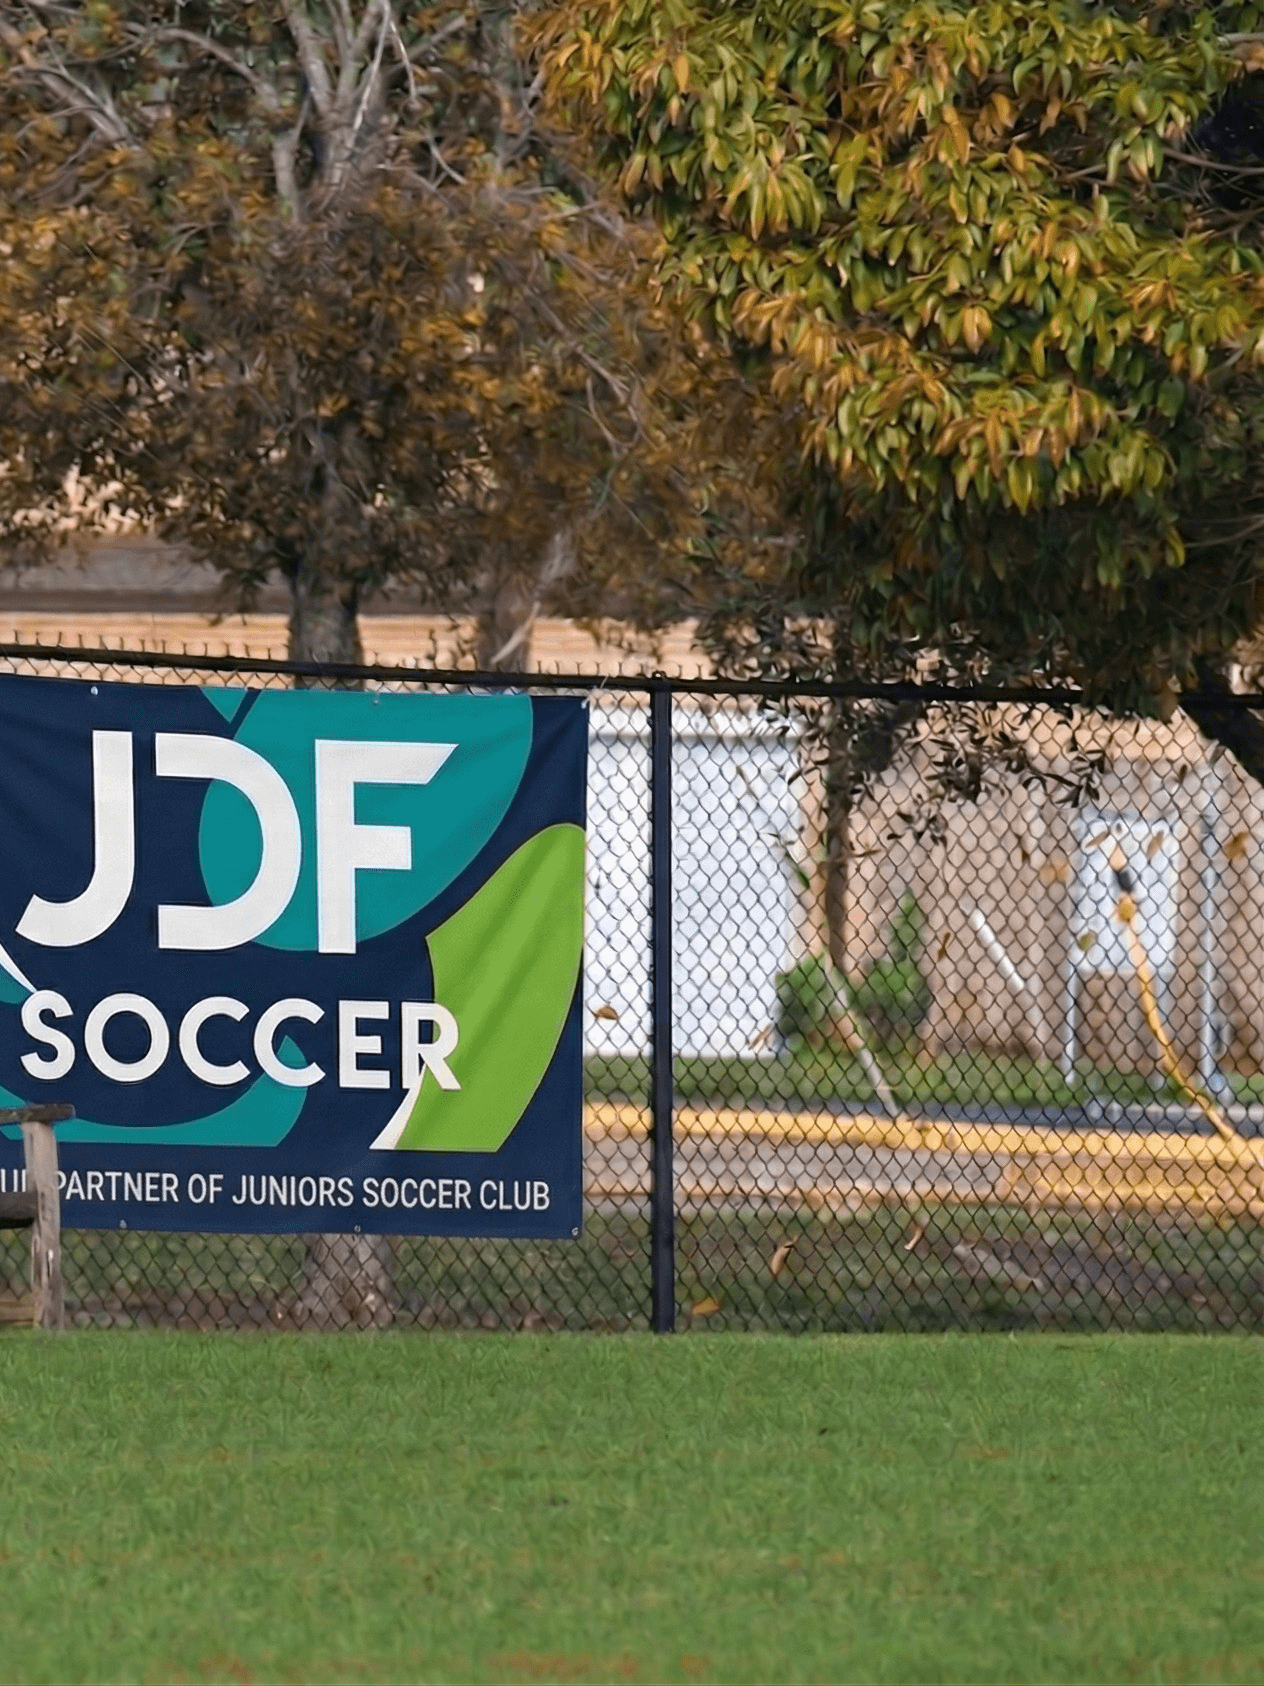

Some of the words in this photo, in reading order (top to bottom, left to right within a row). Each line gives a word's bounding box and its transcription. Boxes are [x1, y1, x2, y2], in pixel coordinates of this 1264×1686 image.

[15, 729, 459, 955] JDF
[20, 988, 462, 1091] SOCCER
[187, 1174, 224, 1204] OF
[232, 1175, 354, 1207] JUNIORS
[362, 1177, 472, 1209] SOCCER
[479, 1180, 550, 1210] CLUB
